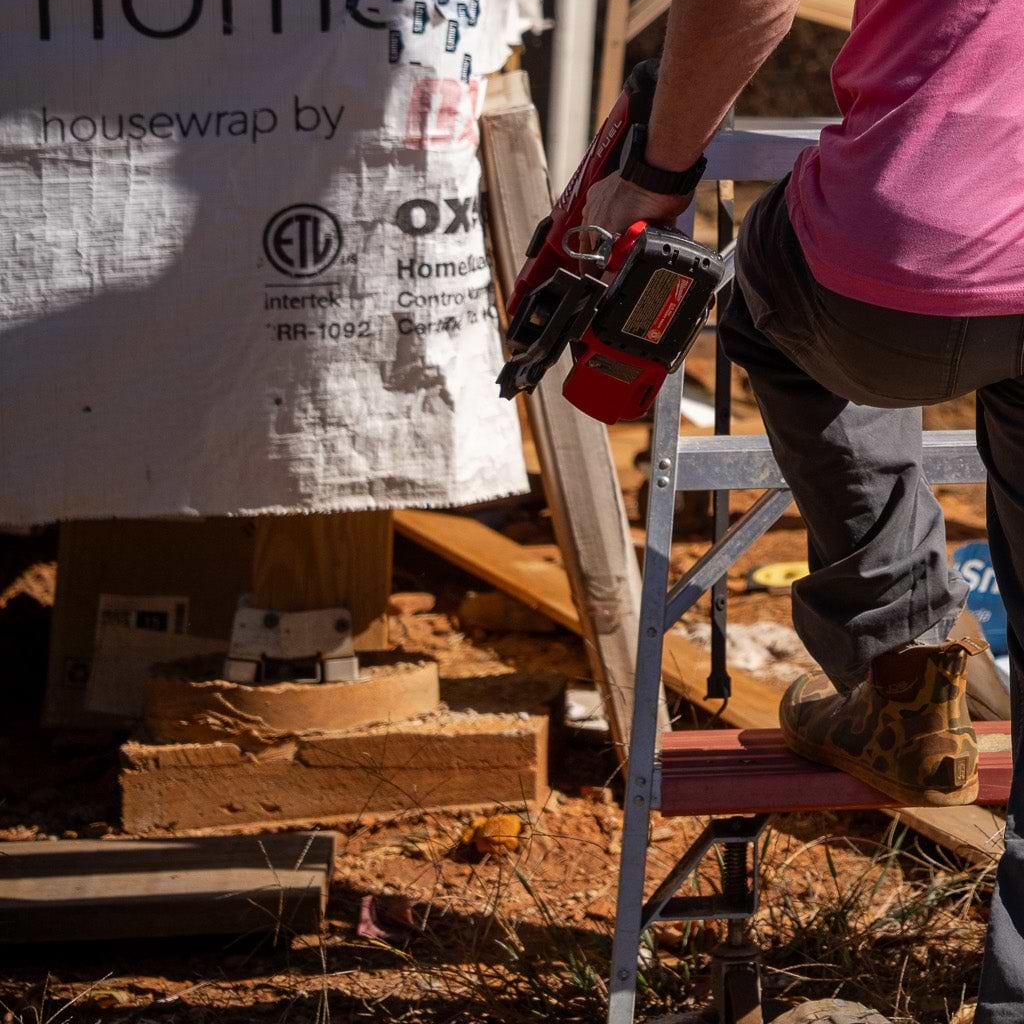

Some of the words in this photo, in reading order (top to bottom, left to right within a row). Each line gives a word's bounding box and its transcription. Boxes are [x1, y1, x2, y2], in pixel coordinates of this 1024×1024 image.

[42, 106, 278, 143] housewrap
[294, 94, 345, 140] by
[597, 120, 622, 157] FUEL
[396, 197, 479, 235] ox
